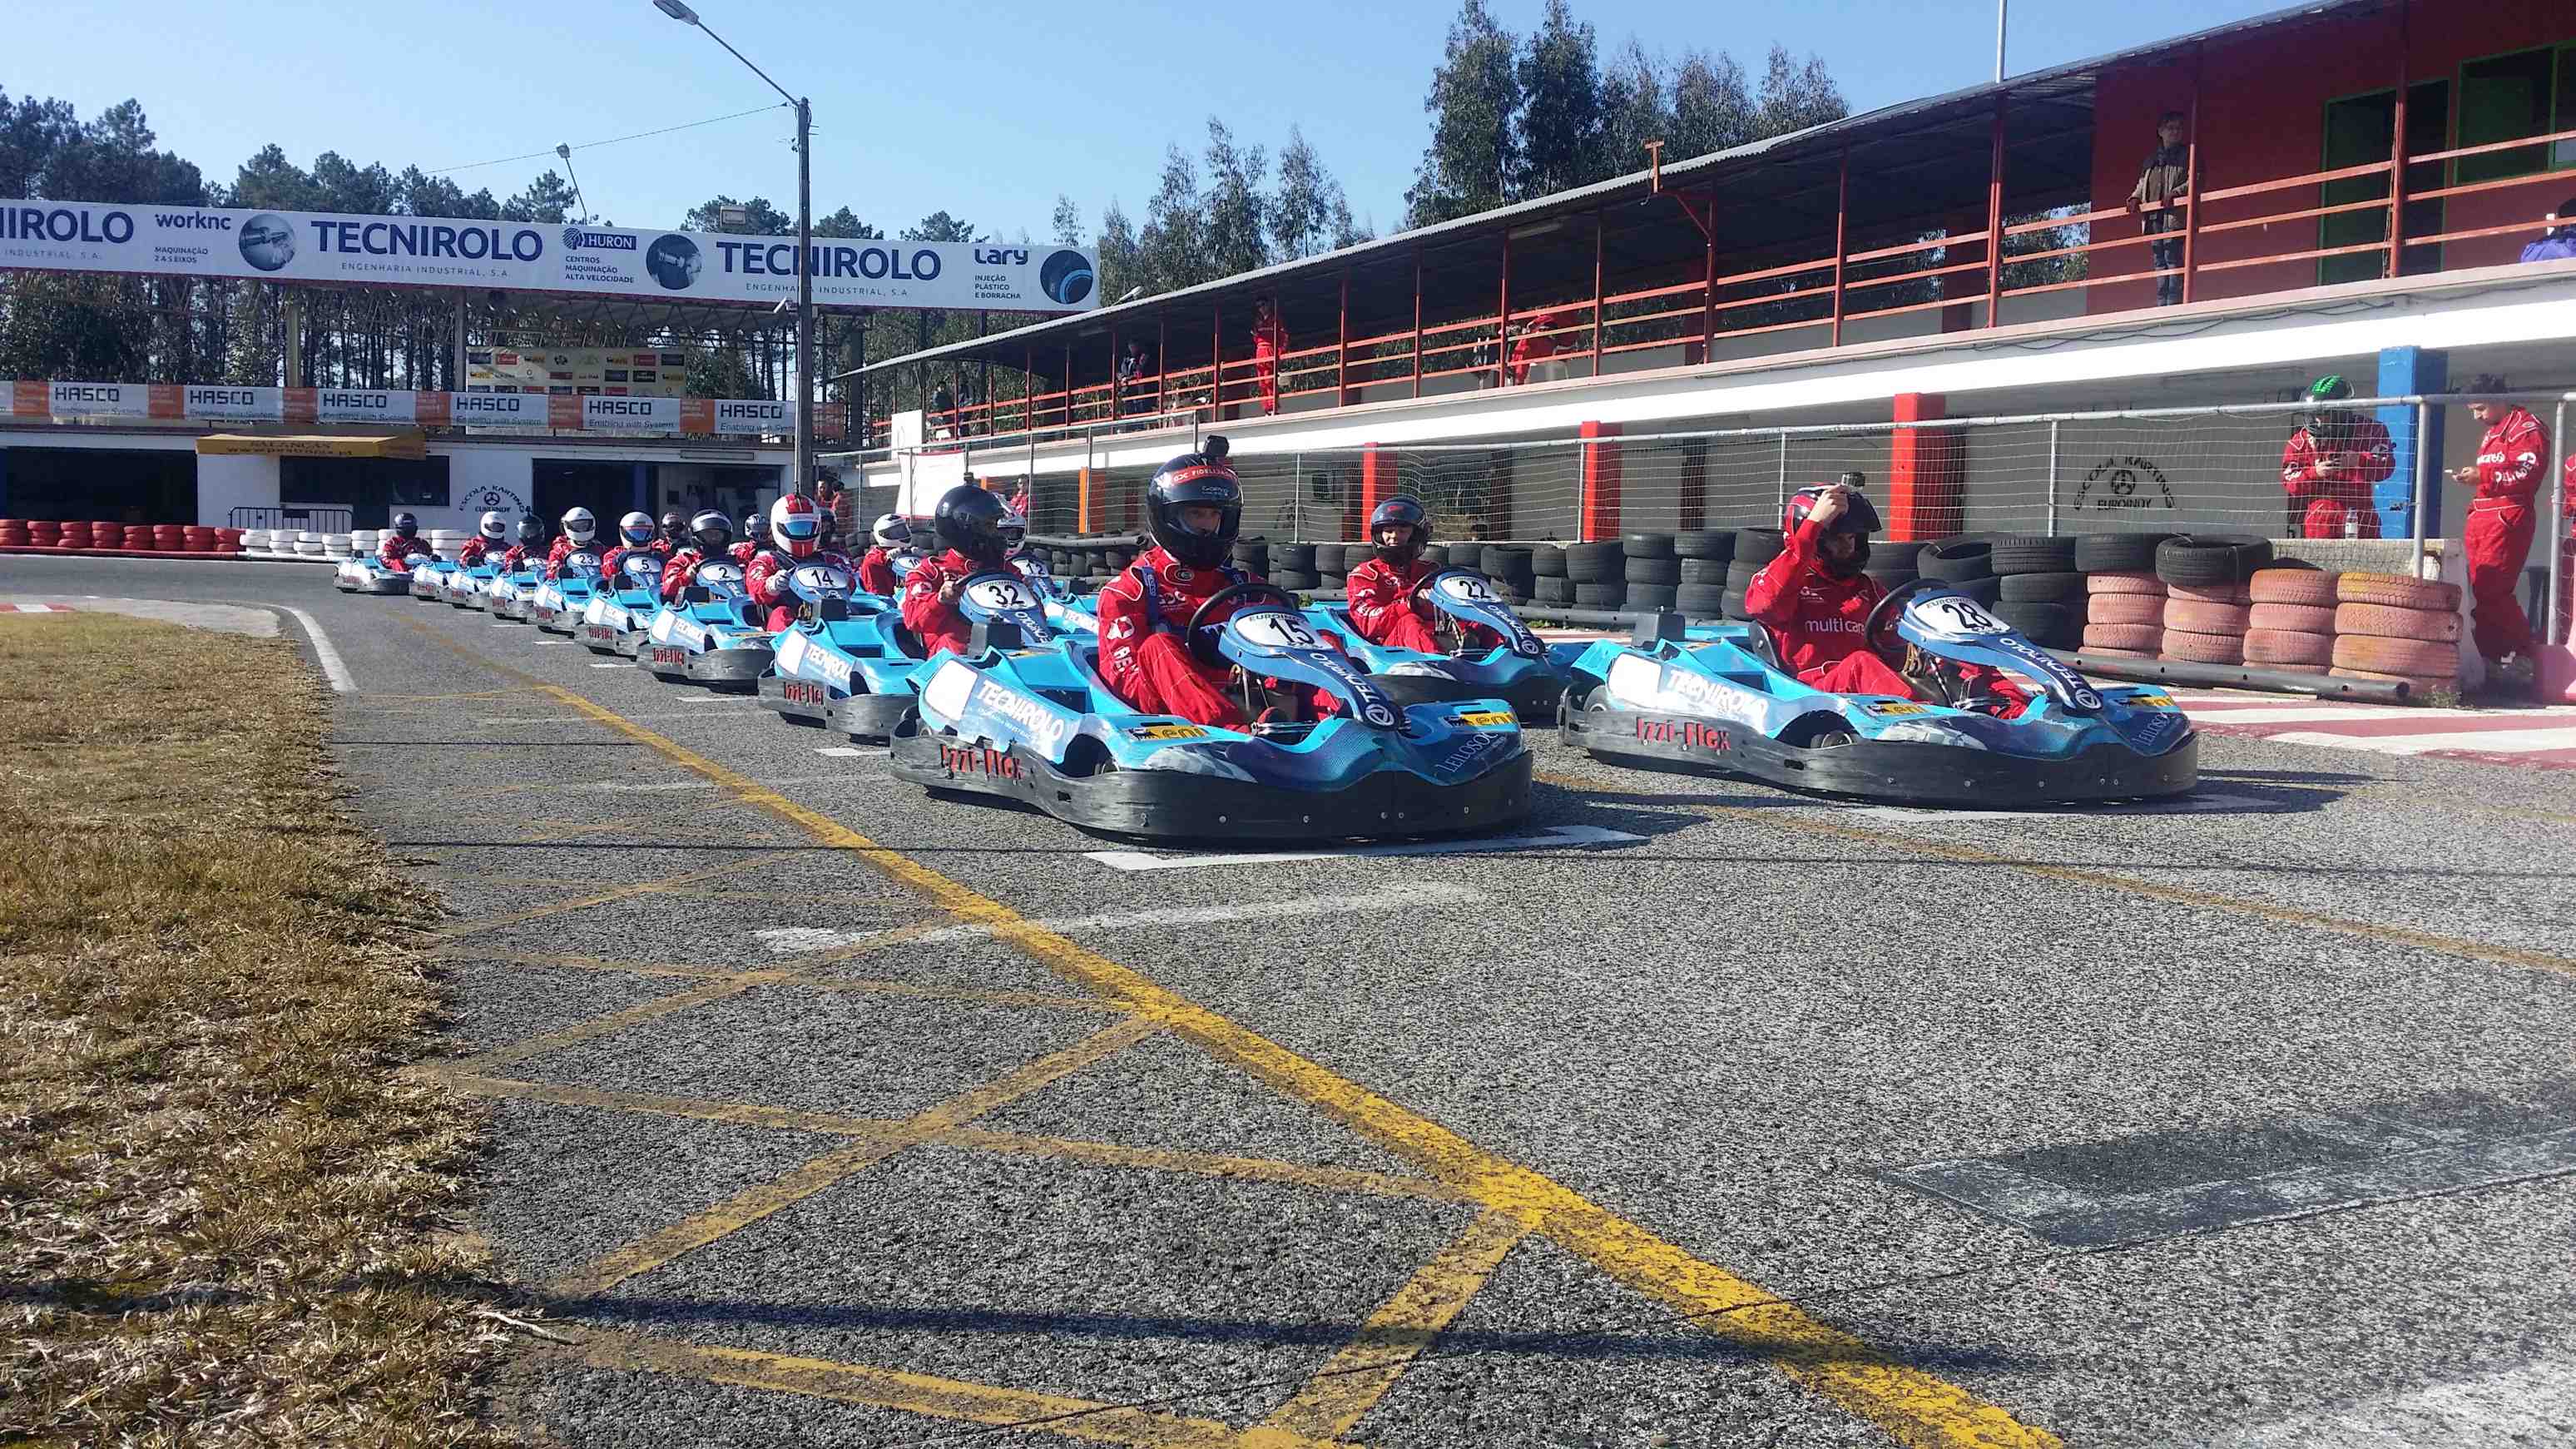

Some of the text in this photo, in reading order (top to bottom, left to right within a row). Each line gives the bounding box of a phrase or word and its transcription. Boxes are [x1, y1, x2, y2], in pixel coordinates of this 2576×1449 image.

[0, 207, 134, 244] IROLO
[155, 211, 231, 231] worknc
[310, 221, 543, 262] TECNIROLO
[588, 236, 632, 249] HURON
[566, 256, 600, 264] CENTROS
[716, 241, 942, 281] TECNIROLO
[341, 262, 412, 273] ENGENHARIA
[417, 265, 485, 277] INDUSTRIAL,
[566, 265, 618, 274] MAQUINAÇÃO
[586, 275, 635, 284] VELOCIDADE
[975, 274, 1006, 283] INJEÇÃO
[820, 285, 885, 296] INDUSTRIAL,
[55, 387, 121, 402] HASCO
[190, 390, 254, 404] HASCO
[323, 393, 387, 408] HASCO
[457, 396, 520, 411] HASCO
[588, 400, 652, 415] HASCO
[721, 404, 783, 419] HASCO
[578, 554, 594, 564] 23
[642, 559, 650, 570] 5
[719, 567, 730, 578] 2
[1025, 562, 1048, 575] 12
[811, 569, 835, 587] 14
[988, 585, 1026, 606] 32
[1459, 580, 1491, 598] 22
[1942, 603, 1993, 630] 28
[1270, 618, 1315, 645] 15
[1806, 618, 1865, 635] multicar
[1999, 638, 2083, 688] TECNIROLO
[1310, 653, 1380, 702] TECNIROLO
[978, 679, 1066, 742] TECNIROLO
